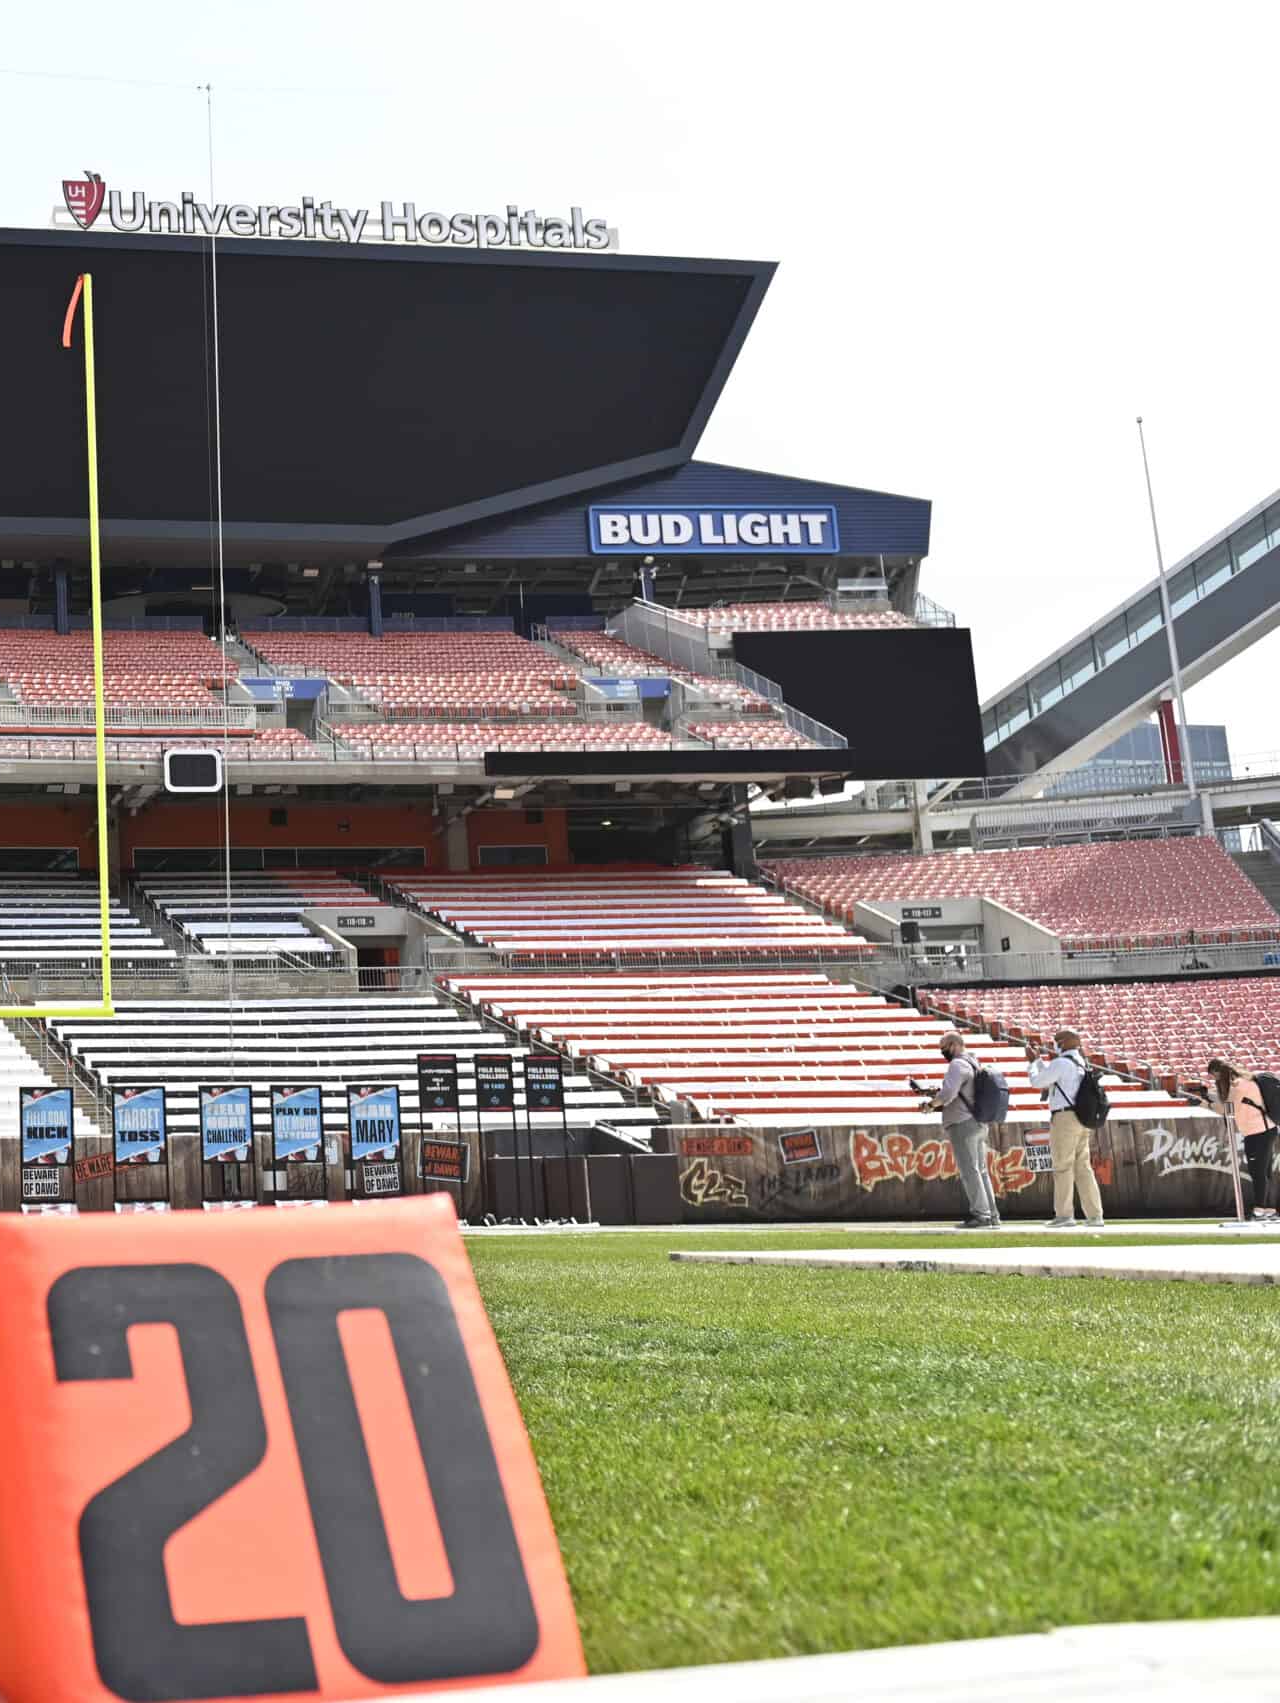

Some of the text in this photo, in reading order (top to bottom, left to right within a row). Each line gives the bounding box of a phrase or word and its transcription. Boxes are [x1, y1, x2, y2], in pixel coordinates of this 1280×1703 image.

[68, 185, 86, 198] UH
[109, 190, 611, 250] University Hospitals
[599, 513, 828, 545] BUD LIGHT
[119, 1107, 160, 1129] TARGET
[276, 1107, 300, 1116] PLAY
[26, 1126, 69, 1140] KICK
[118, 1130, 160, 1142] TOSS
[207, 1128, 247, 1144] CHALLENGE
[356, 1119, 394, 1143] MARY
[1141, 1121, 1219, 1167] DAWG
[23, 1168, 58, 1180] BEWARE
[75, 1157, 113, 1180] BEWARE
[365, 1164, 397, 1176] BEWARE
[23, 1182, 58, 1196] OF DAWG
[366, 1176, 399, 1190] OF DAWG
[46, 1252, 540, 1701] 20
